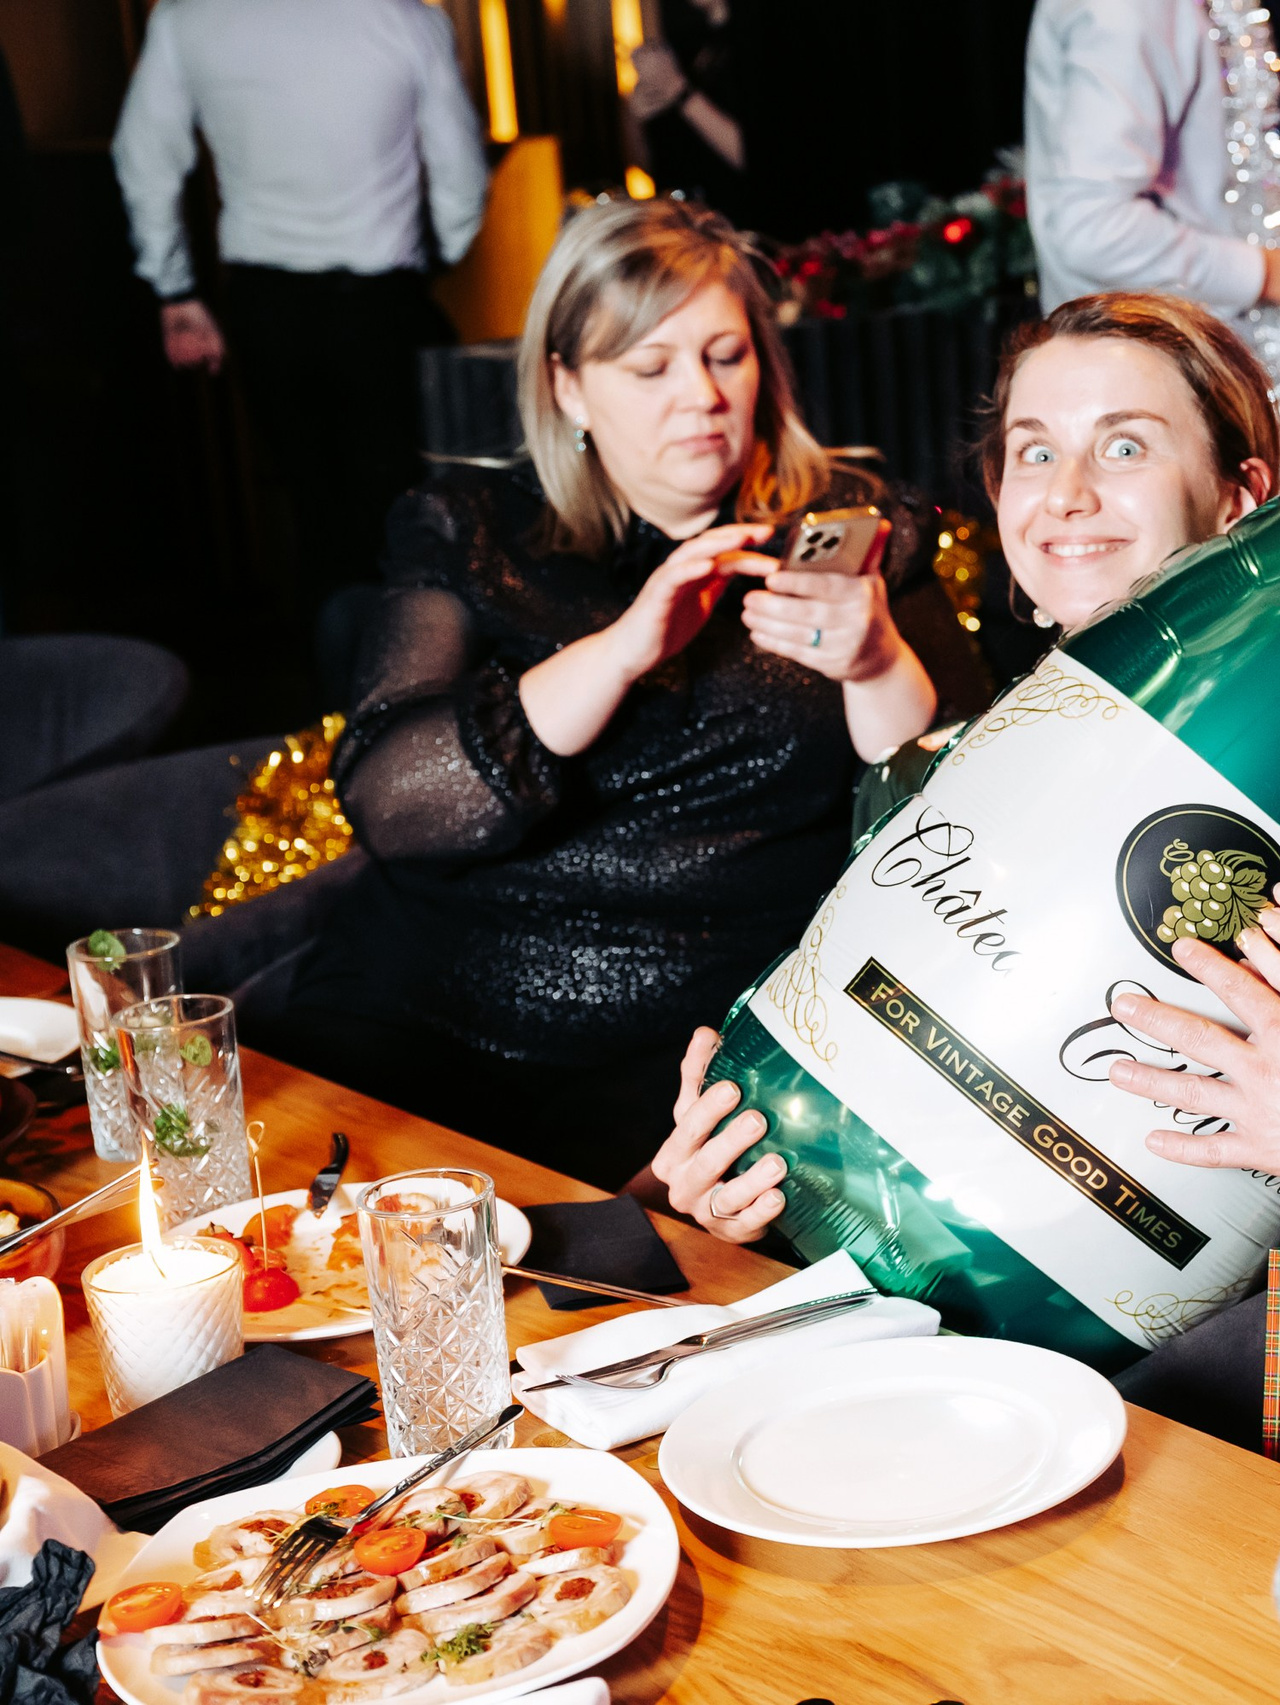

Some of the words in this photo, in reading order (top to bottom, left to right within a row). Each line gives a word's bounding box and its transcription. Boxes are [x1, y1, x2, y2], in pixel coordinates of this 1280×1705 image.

[870, 982, 921, 1035] FOR
[926, 1025, 1031, 1129] VINTAGE
[1032, 1123, 1109, 1190] GOOD
[1113, 1183, 1184, 1249] TIMES
